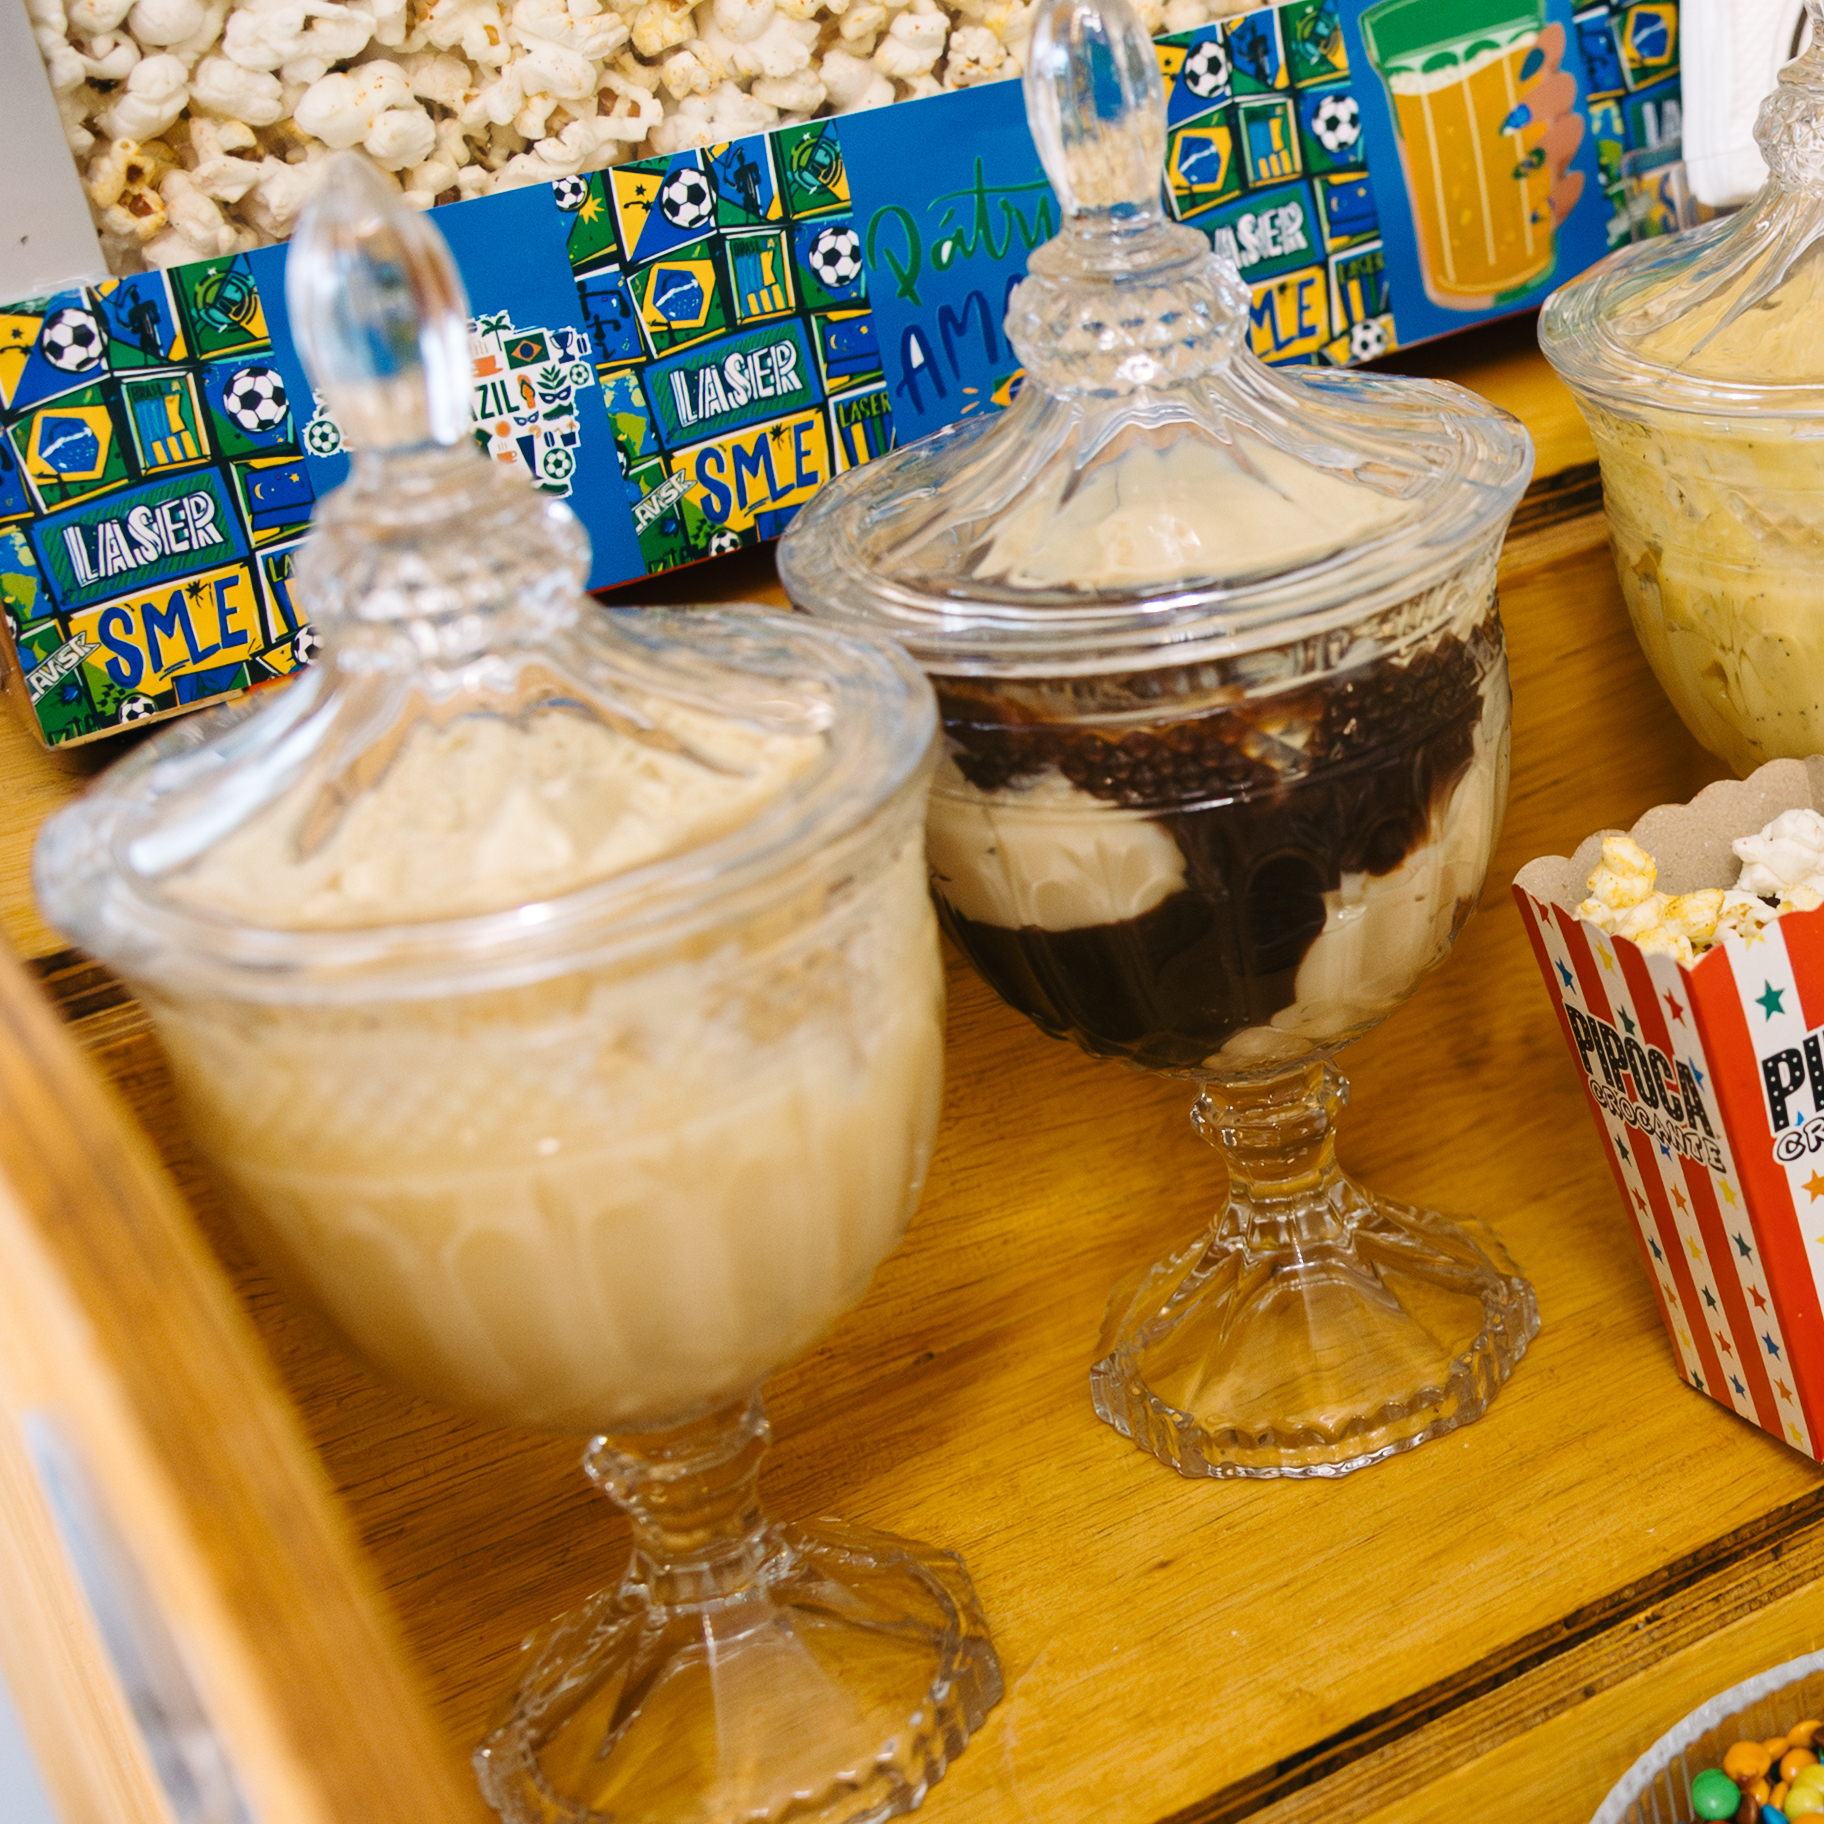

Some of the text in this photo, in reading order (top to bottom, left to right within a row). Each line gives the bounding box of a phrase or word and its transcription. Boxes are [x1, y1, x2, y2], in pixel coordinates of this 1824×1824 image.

[670, 339, 803, 428] LASER
[896, 272, 1028, 416] AM
[470, 379, 521, 422] ZIL
[837, 390, 892, 429] LASER
[63, 490, 225, 589] LASER
[1564, 1002, 1716, 1140] PIPOCA
[1589, 1079, 1727, 1174] CROCANTE
